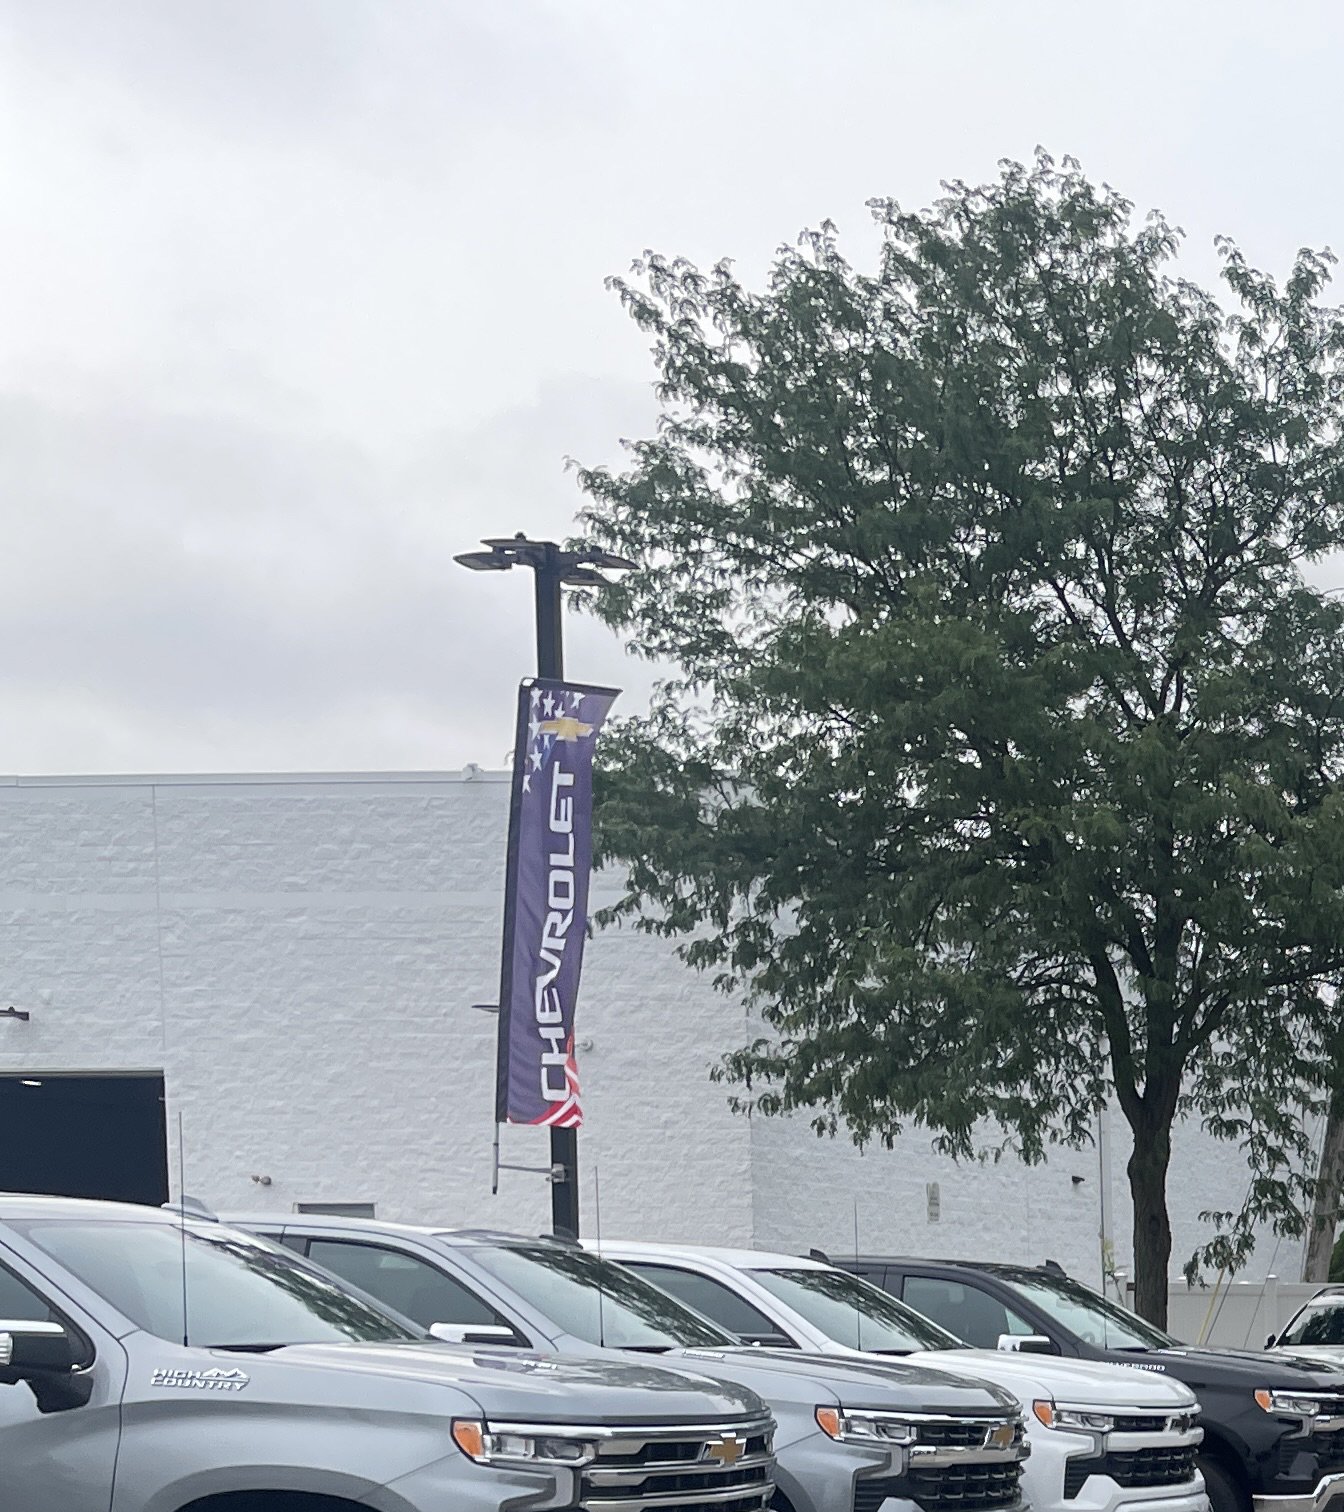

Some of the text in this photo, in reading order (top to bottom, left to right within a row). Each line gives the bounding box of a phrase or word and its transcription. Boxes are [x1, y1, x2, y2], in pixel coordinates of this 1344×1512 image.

[535, 760, 575, 1102] CHEVROLET
[153, 1368, 202, 1379] HIGH
[150, 1377, 246, 1392] COUNTRY
